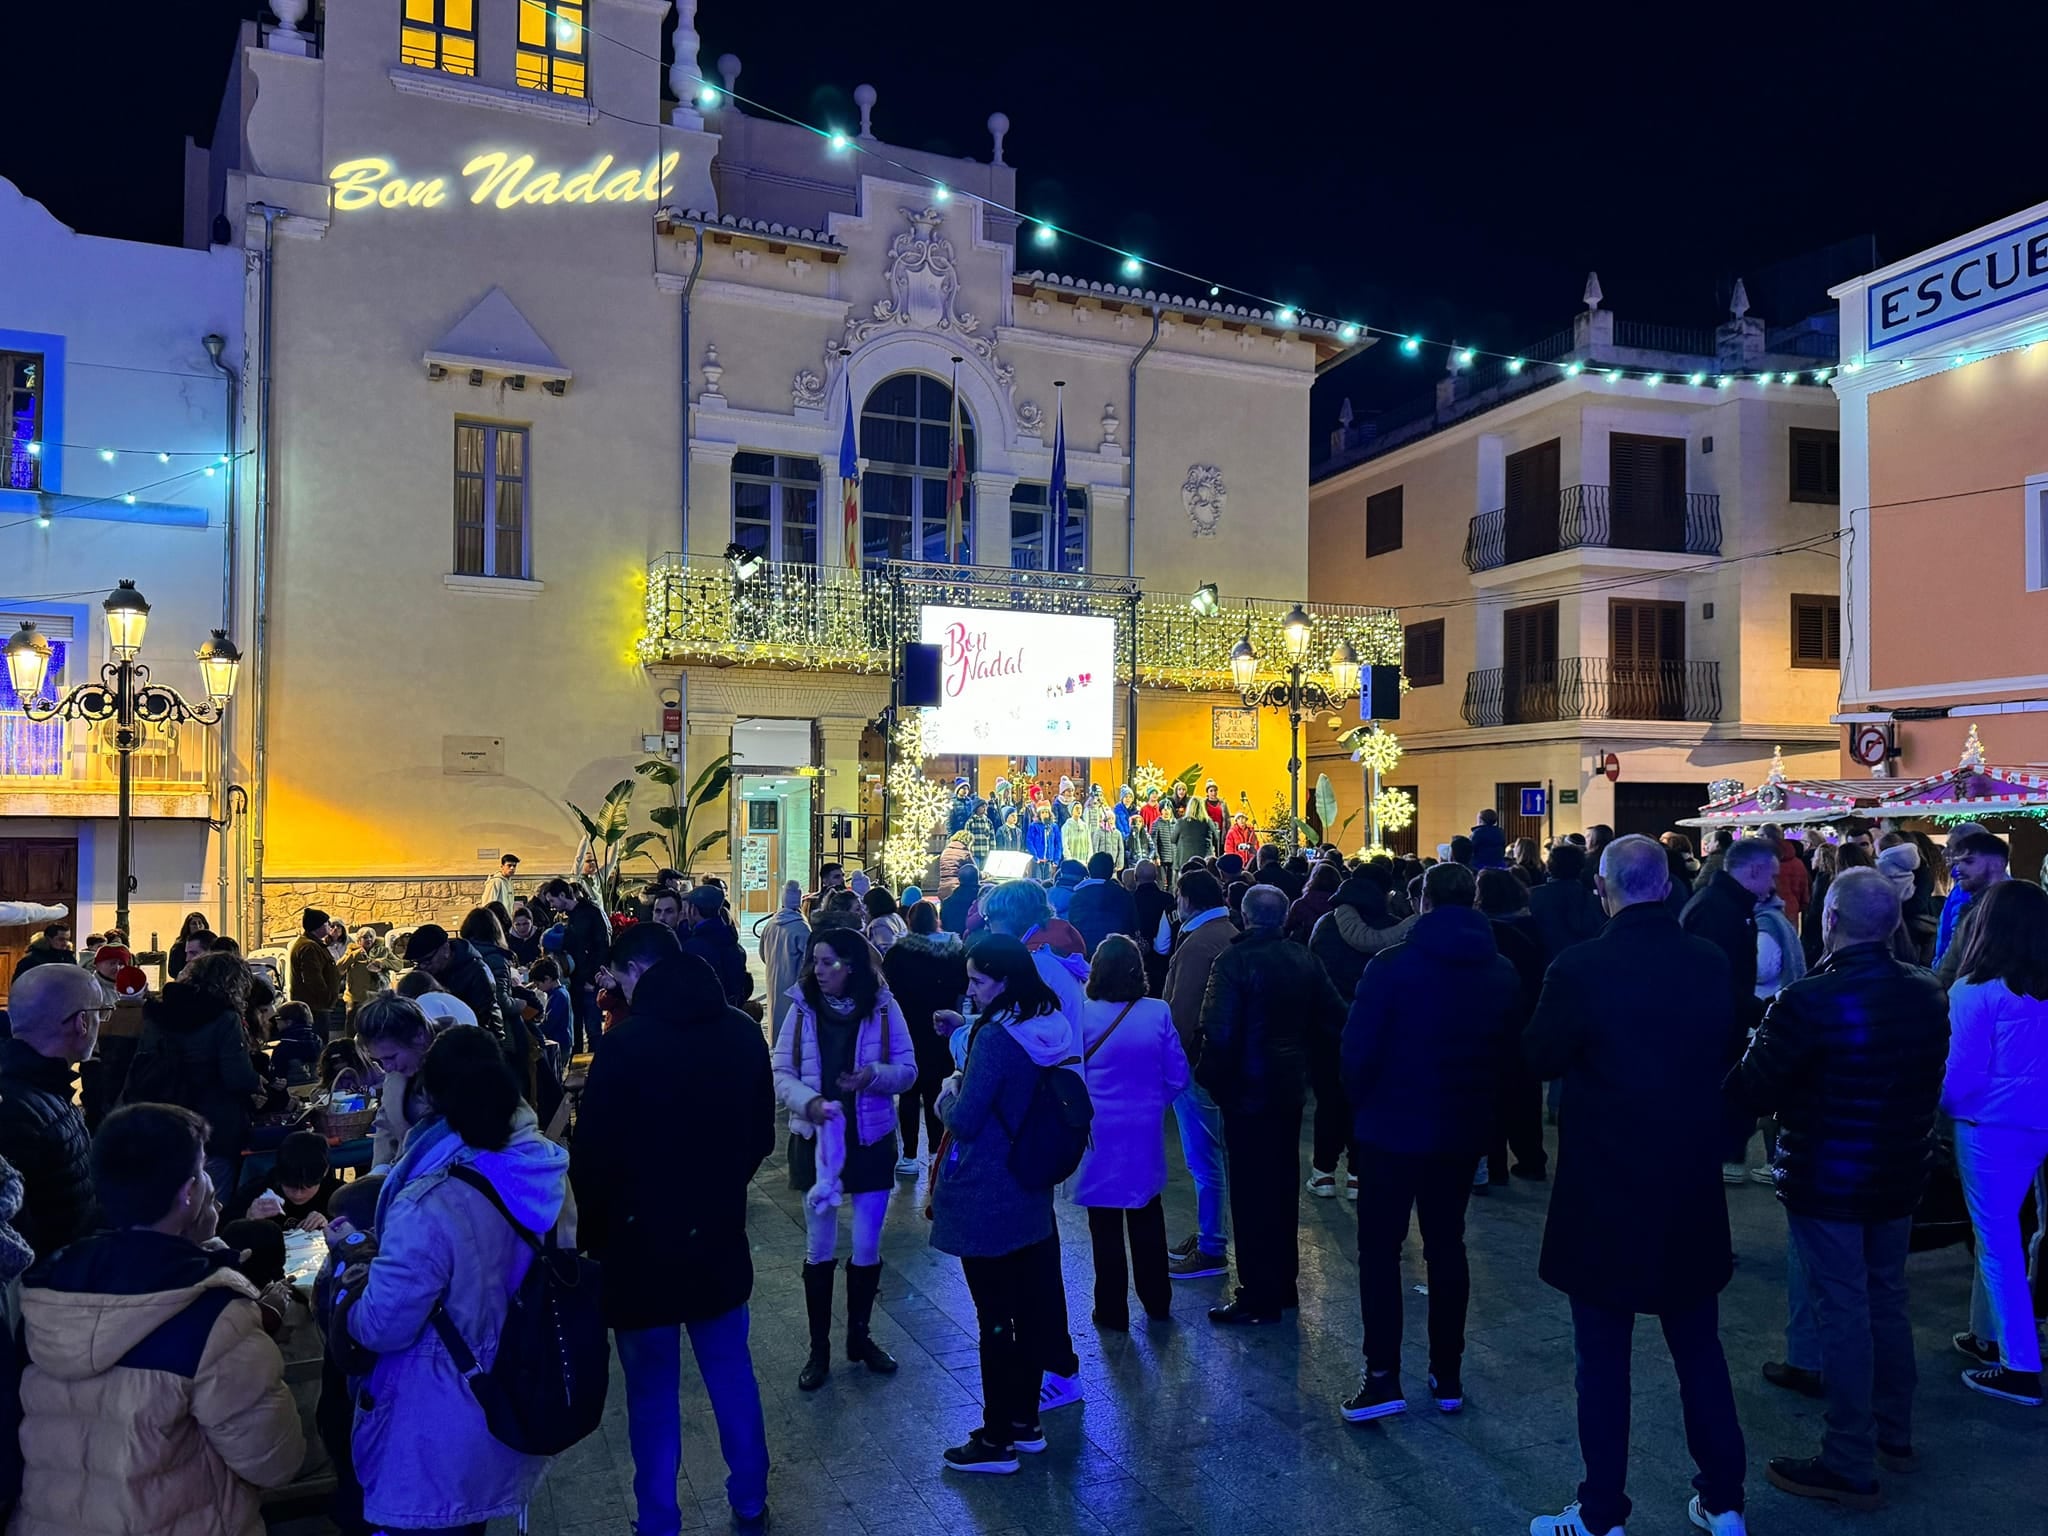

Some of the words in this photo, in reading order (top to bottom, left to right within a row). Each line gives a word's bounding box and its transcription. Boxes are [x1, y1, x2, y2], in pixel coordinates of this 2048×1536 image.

[327, 157, 446, 210] Bon
[461, 151, 680, 209] Nadal
[1881, 232, 2048, 330] ESCUE
[942, 622, 987, 666] Bon
[946, 647, 1024, 697] Nadal
